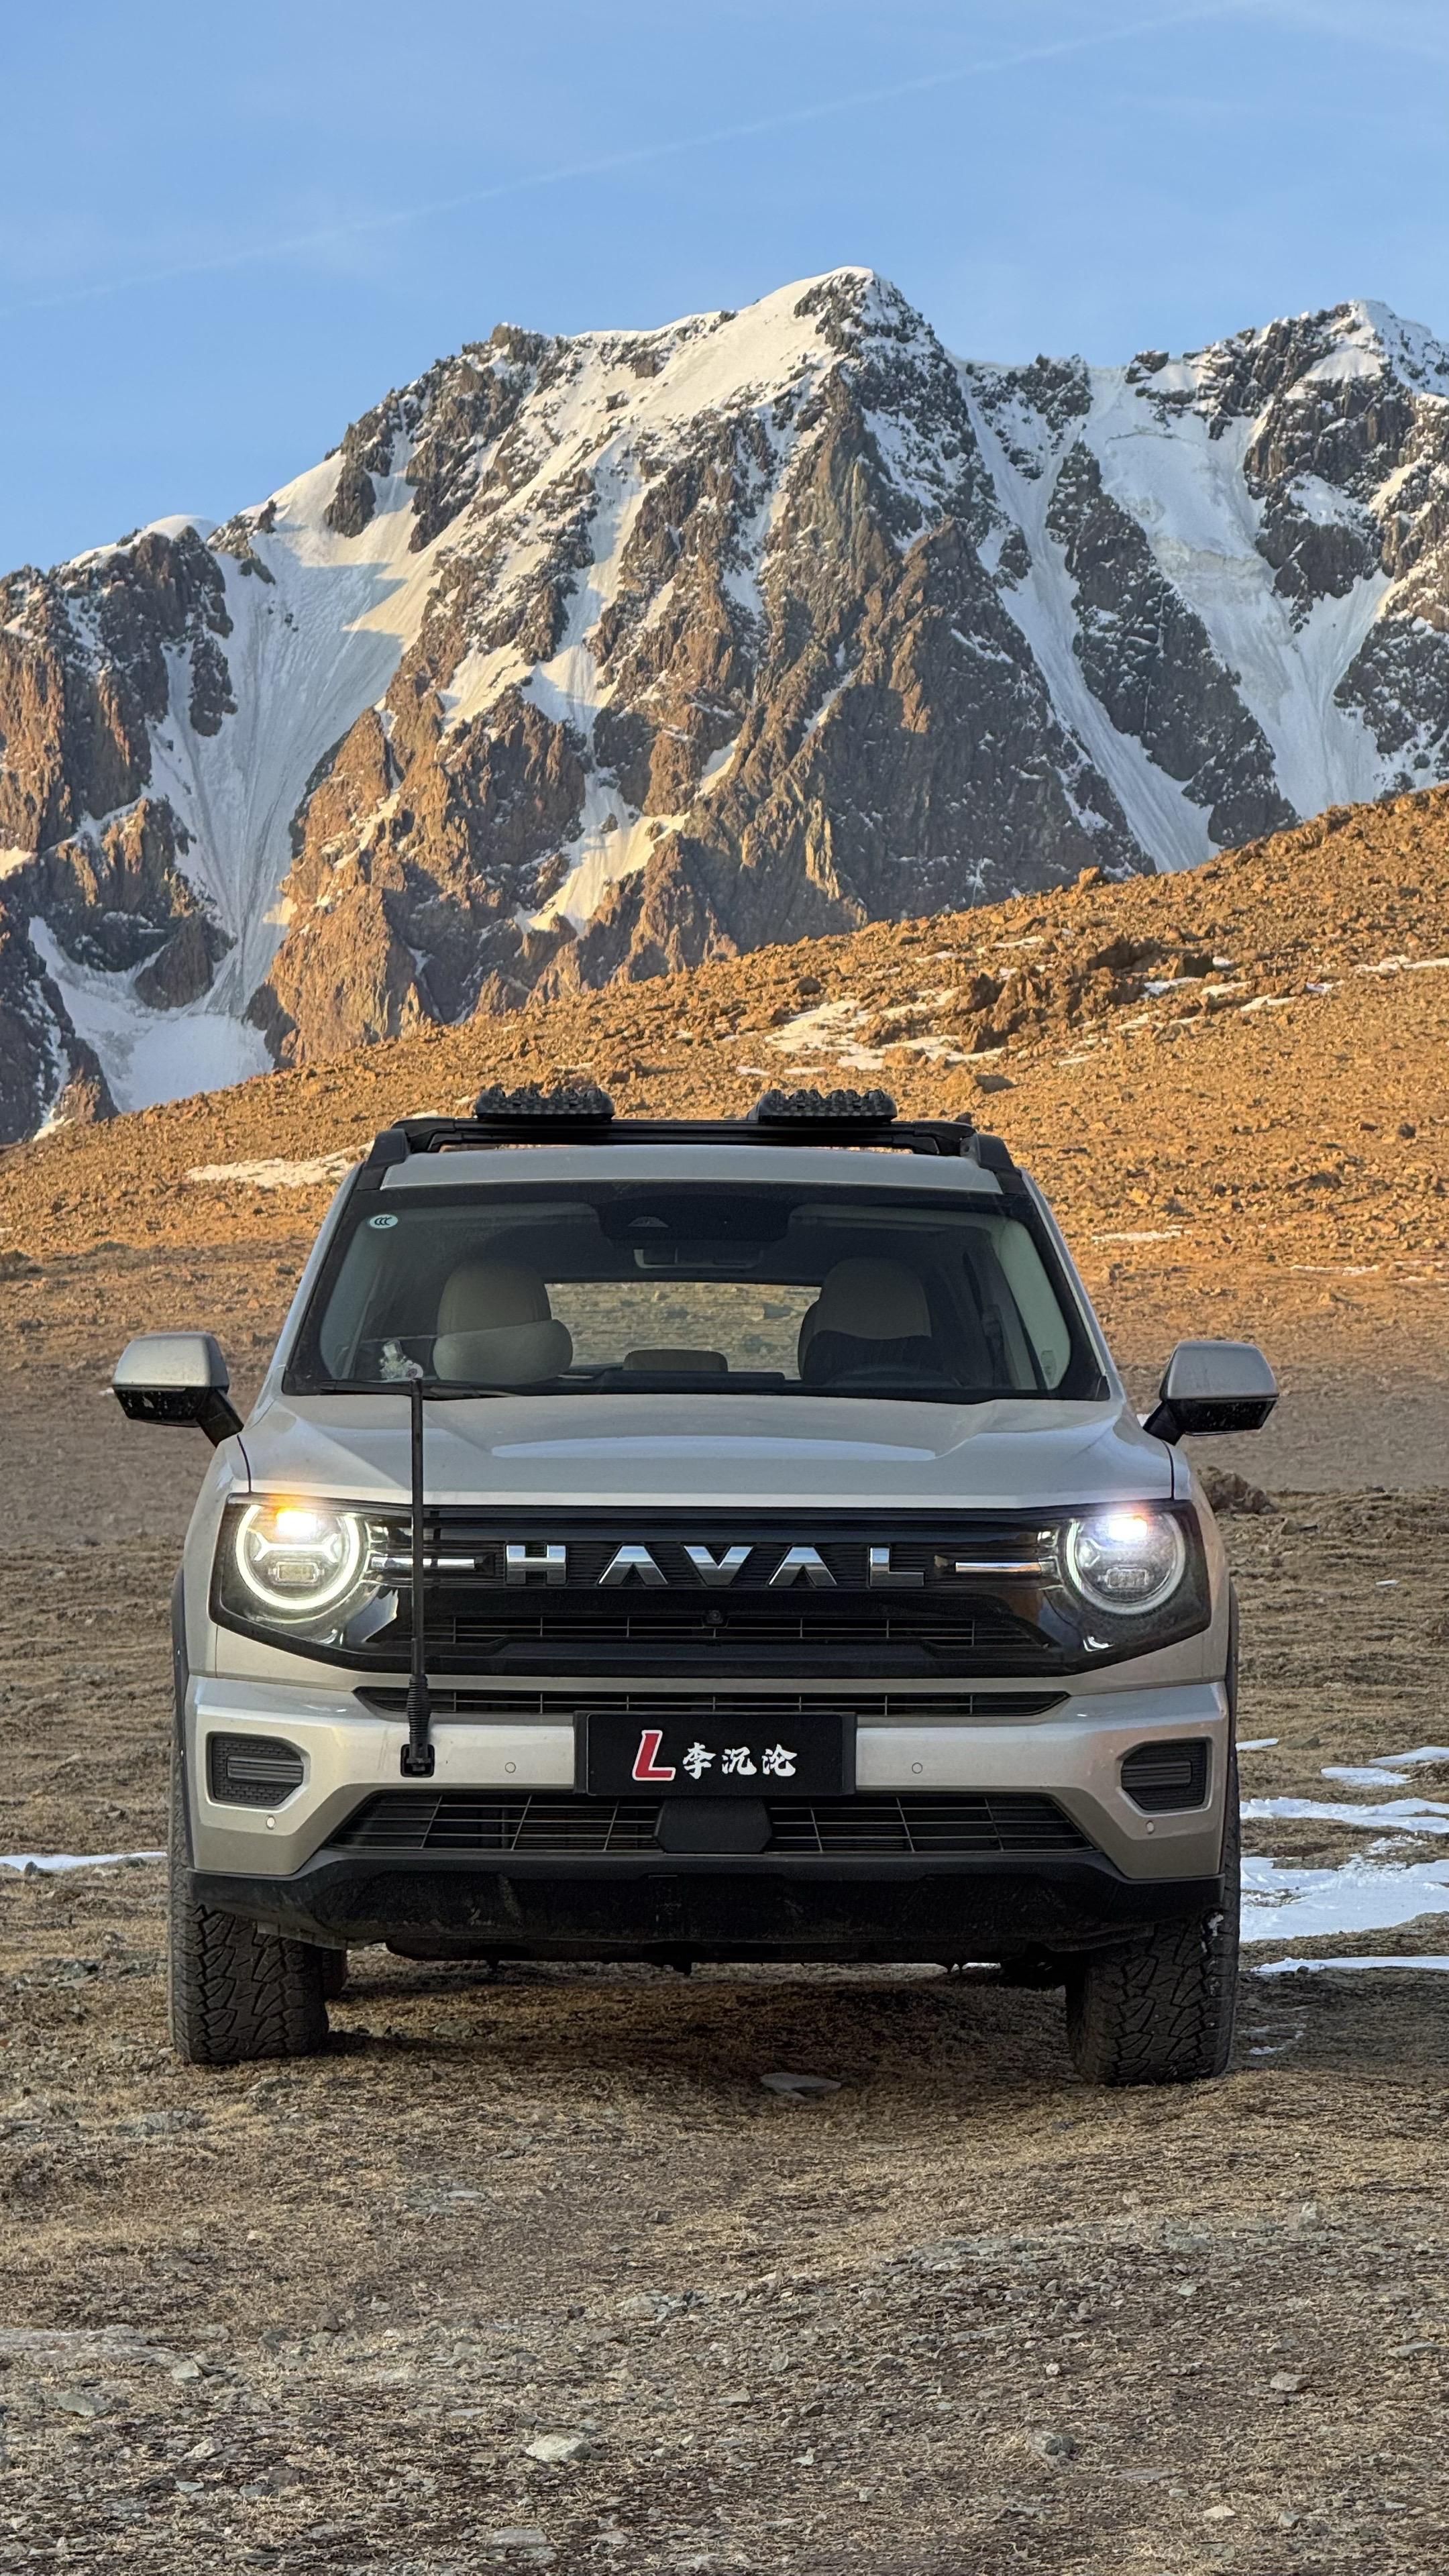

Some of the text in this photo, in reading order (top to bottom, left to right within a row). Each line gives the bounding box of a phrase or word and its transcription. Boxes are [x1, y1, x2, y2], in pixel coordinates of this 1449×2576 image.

[374, 1217, 392, 1226] CCC
[505, 1544, 925, 1587] HAVAL
[633, 1729, 798, 1781] L 李沉沦
